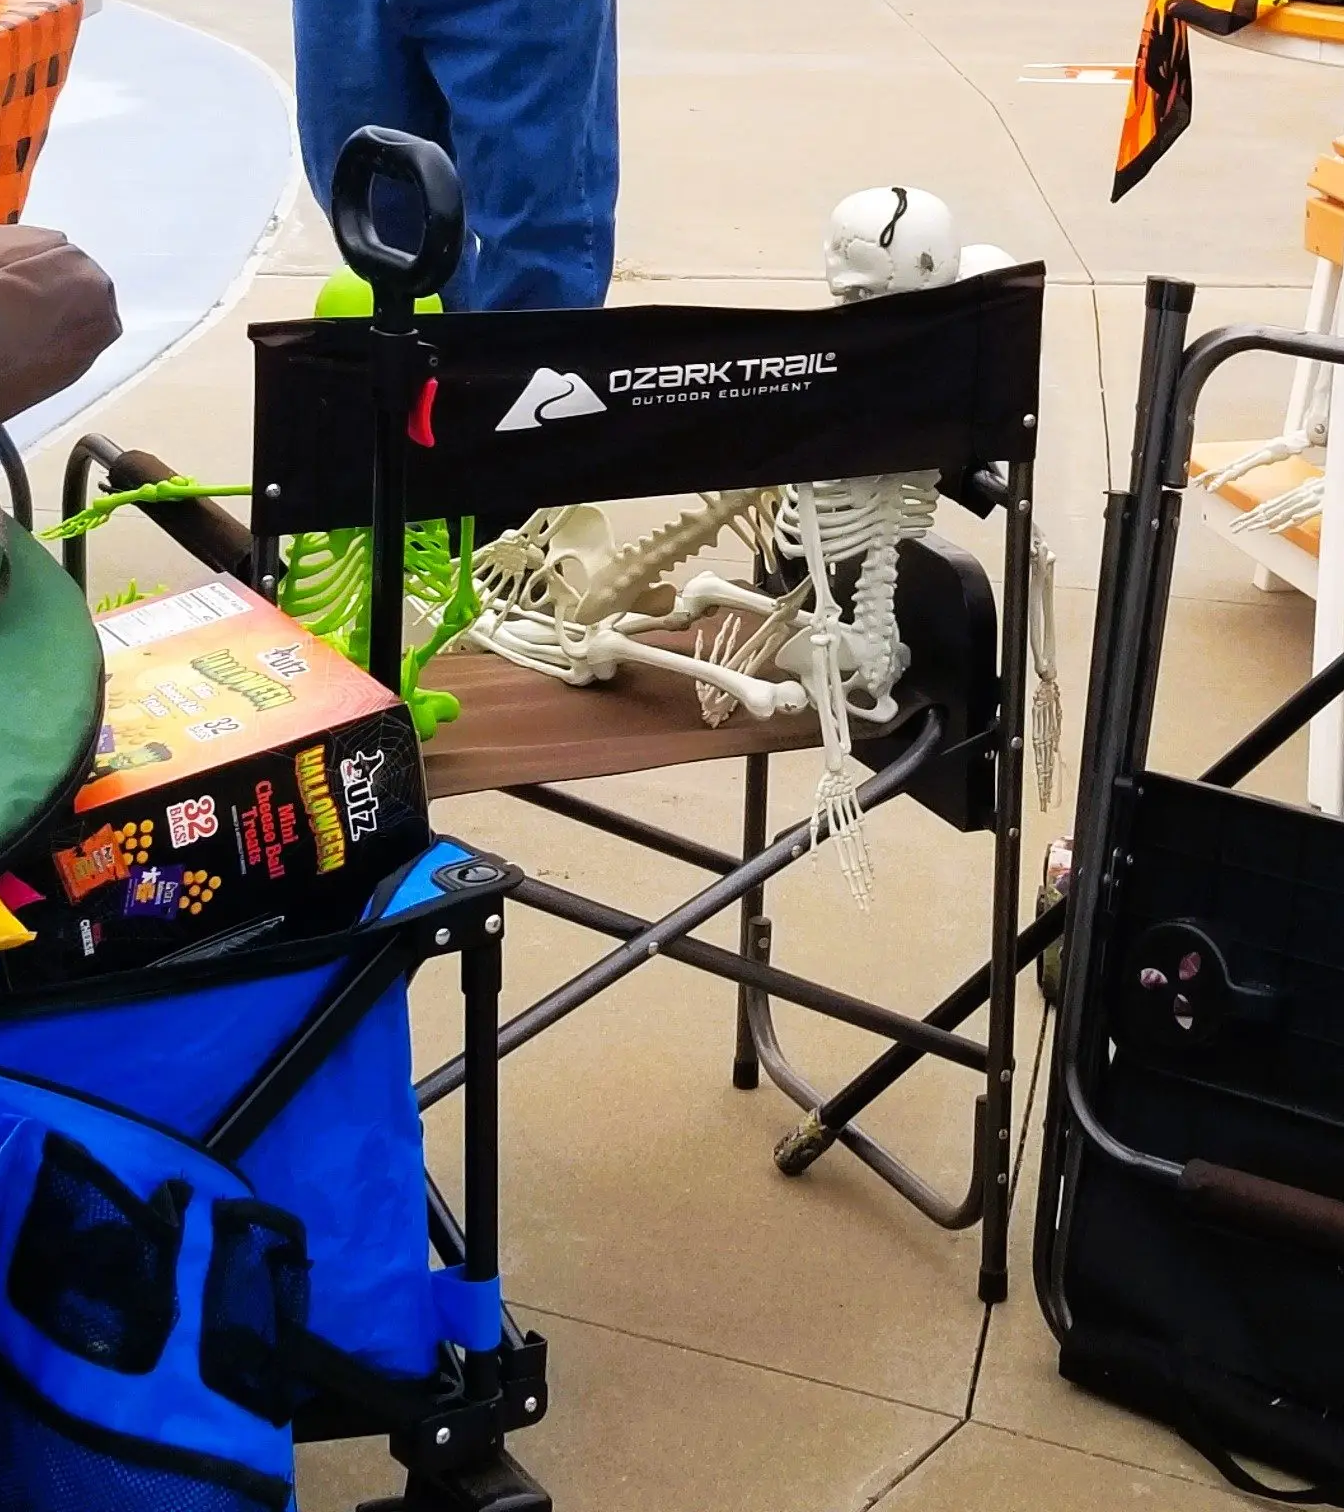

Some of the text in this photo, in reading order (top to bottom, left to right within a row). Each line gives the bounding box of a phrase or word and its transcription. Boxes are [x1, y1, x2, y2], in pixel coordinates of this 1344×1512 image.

[632, 381, 812, 406] OUTDOOR EQUIPMENT
[204, 716, 240, 734] 32
[168, 805, 187, 847] BAGS!
[183, 796, 216, 840] 32
[256, 780, 285, 879] Cheese Ball
[277, 803, 298, 845] Mini
[295, 744, 346, 874] HALLOWEEN
[241, 805, 261, 866] Treats
[79, 919, 95, 956] CHEESE
